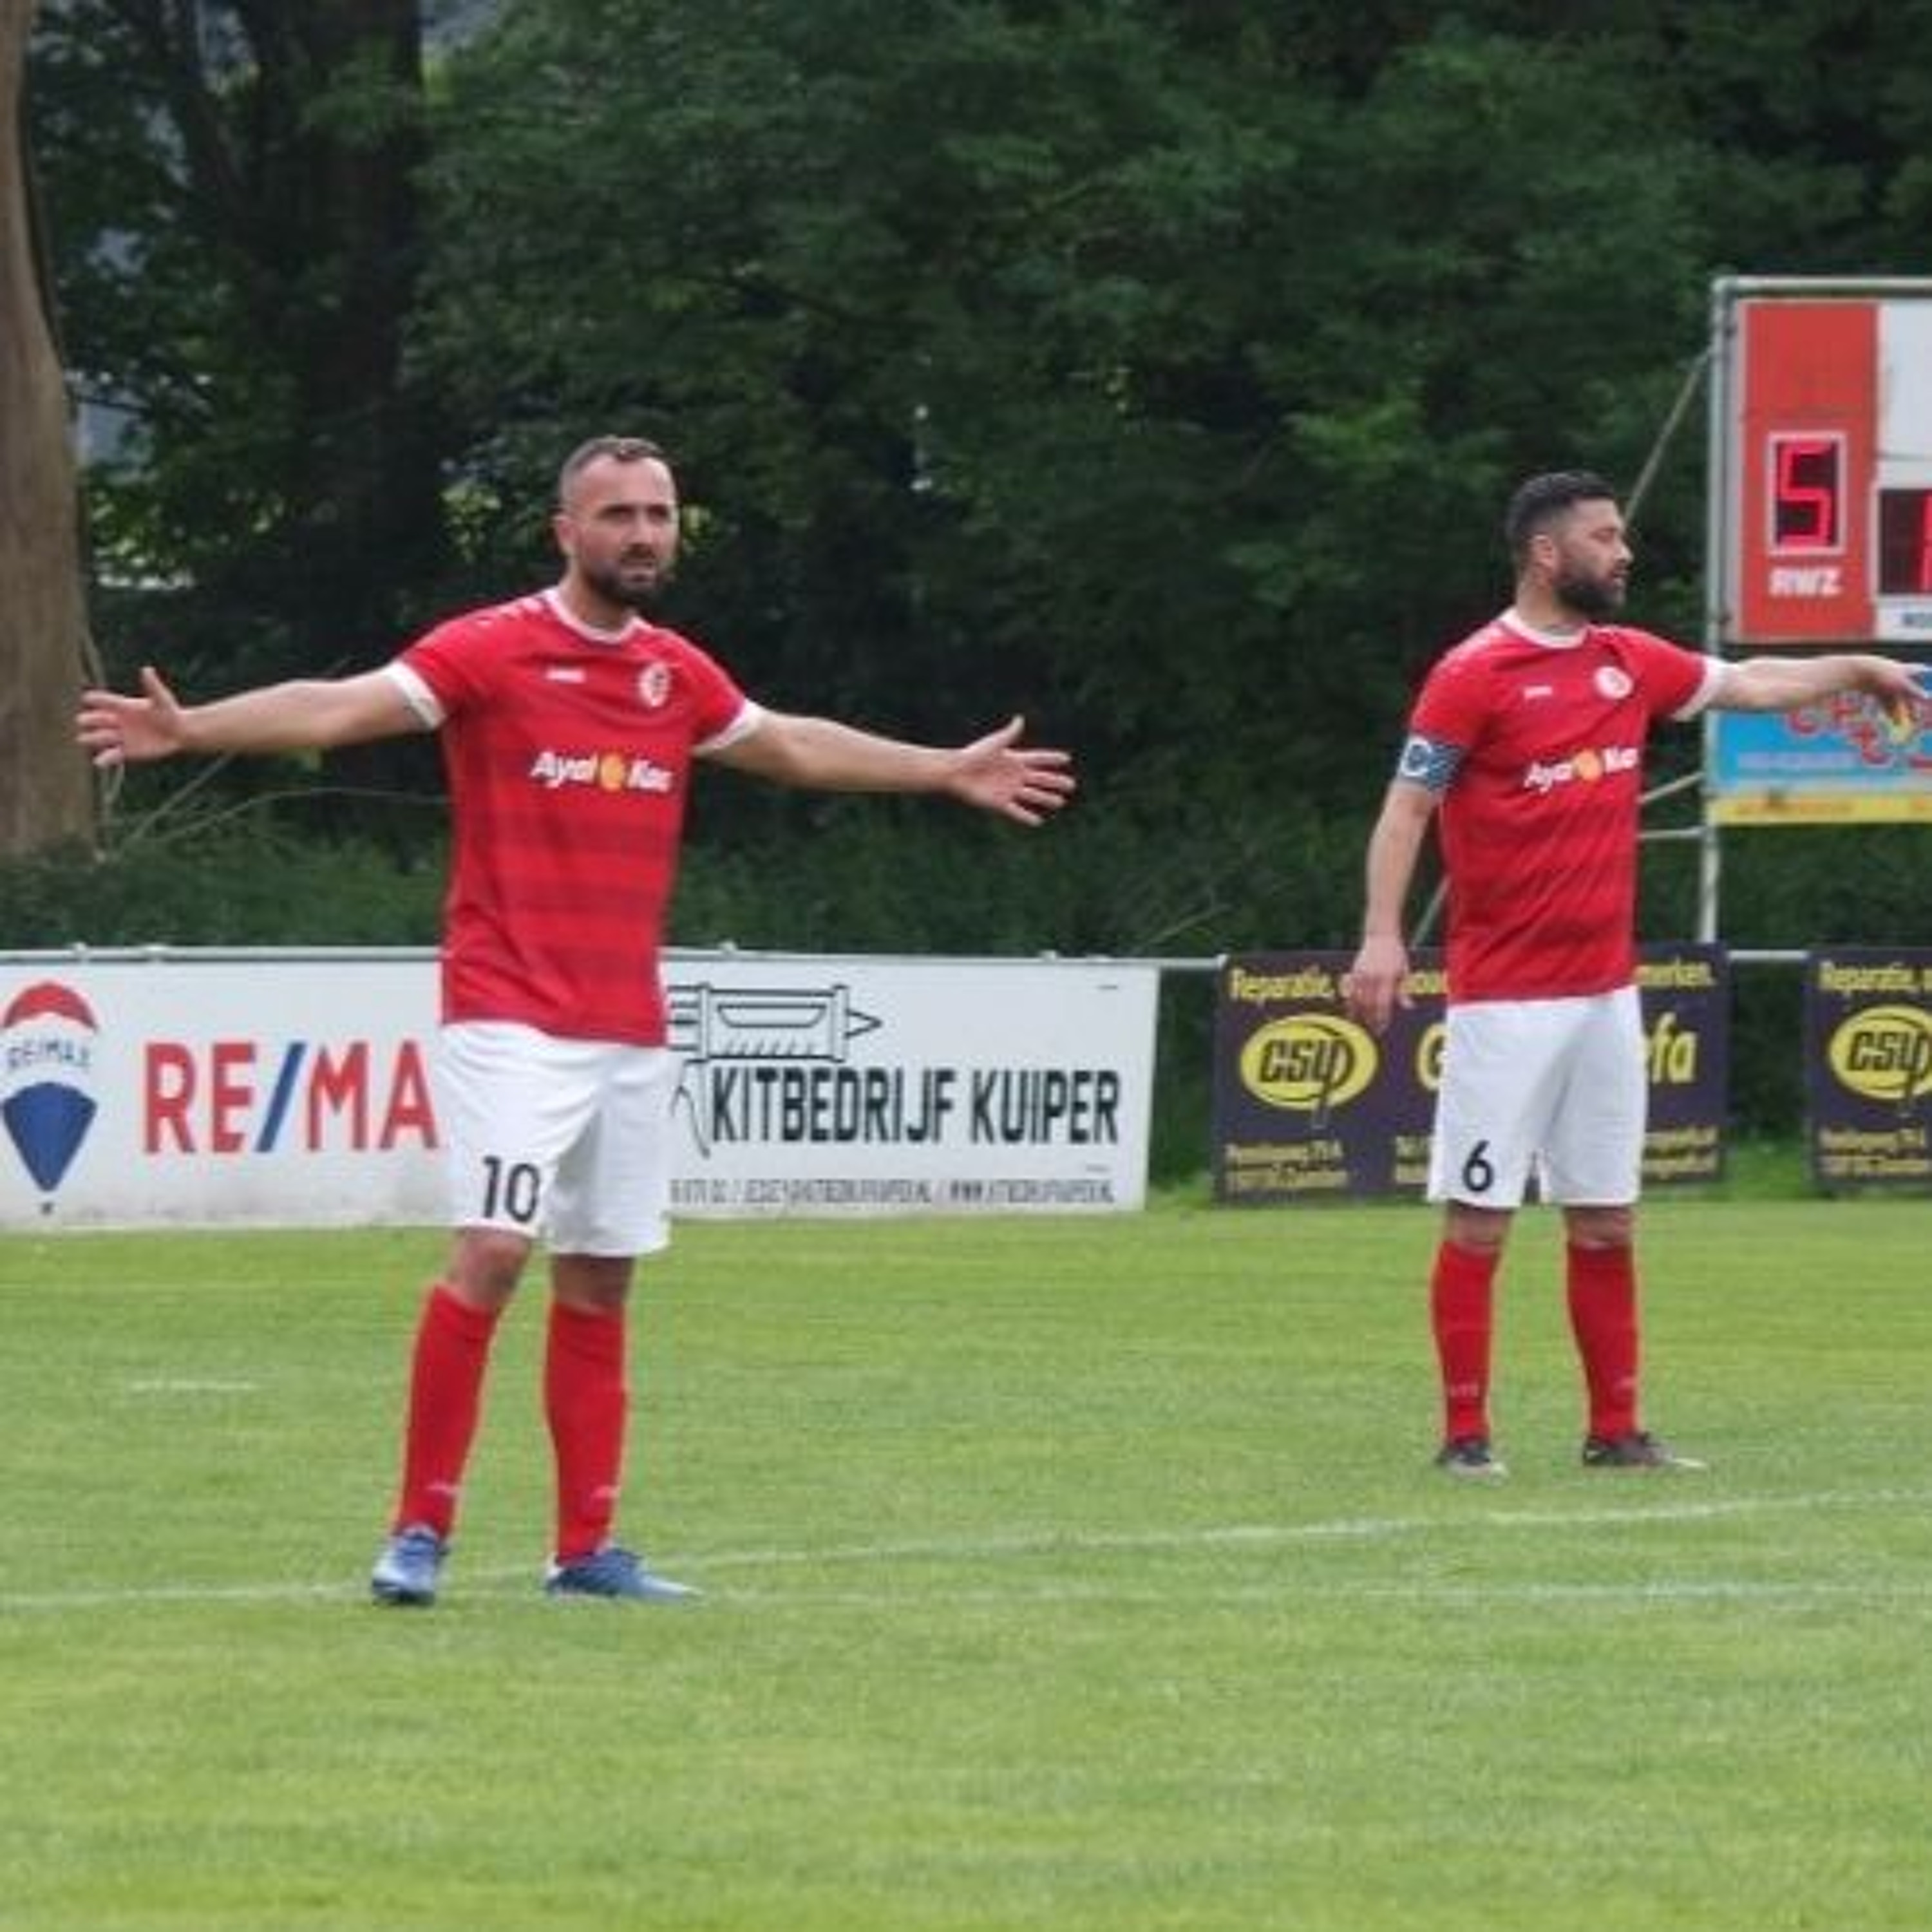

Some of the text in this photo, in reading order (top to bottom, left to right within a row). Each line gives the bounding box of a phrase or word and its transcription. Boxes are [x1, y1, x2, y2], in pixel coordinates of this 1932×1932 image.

[1779, 440, 1834, 546] 5
[1769, 567, 1842, 597] RWZ
[145, 1042, 439, 1152] RE/MA
[711, 1066, 1119, 1145] KITBEDRIJF KUIPER
[483, 1155, 540, 1223] 10
[1463, 1140, 1495, 1193] 6
